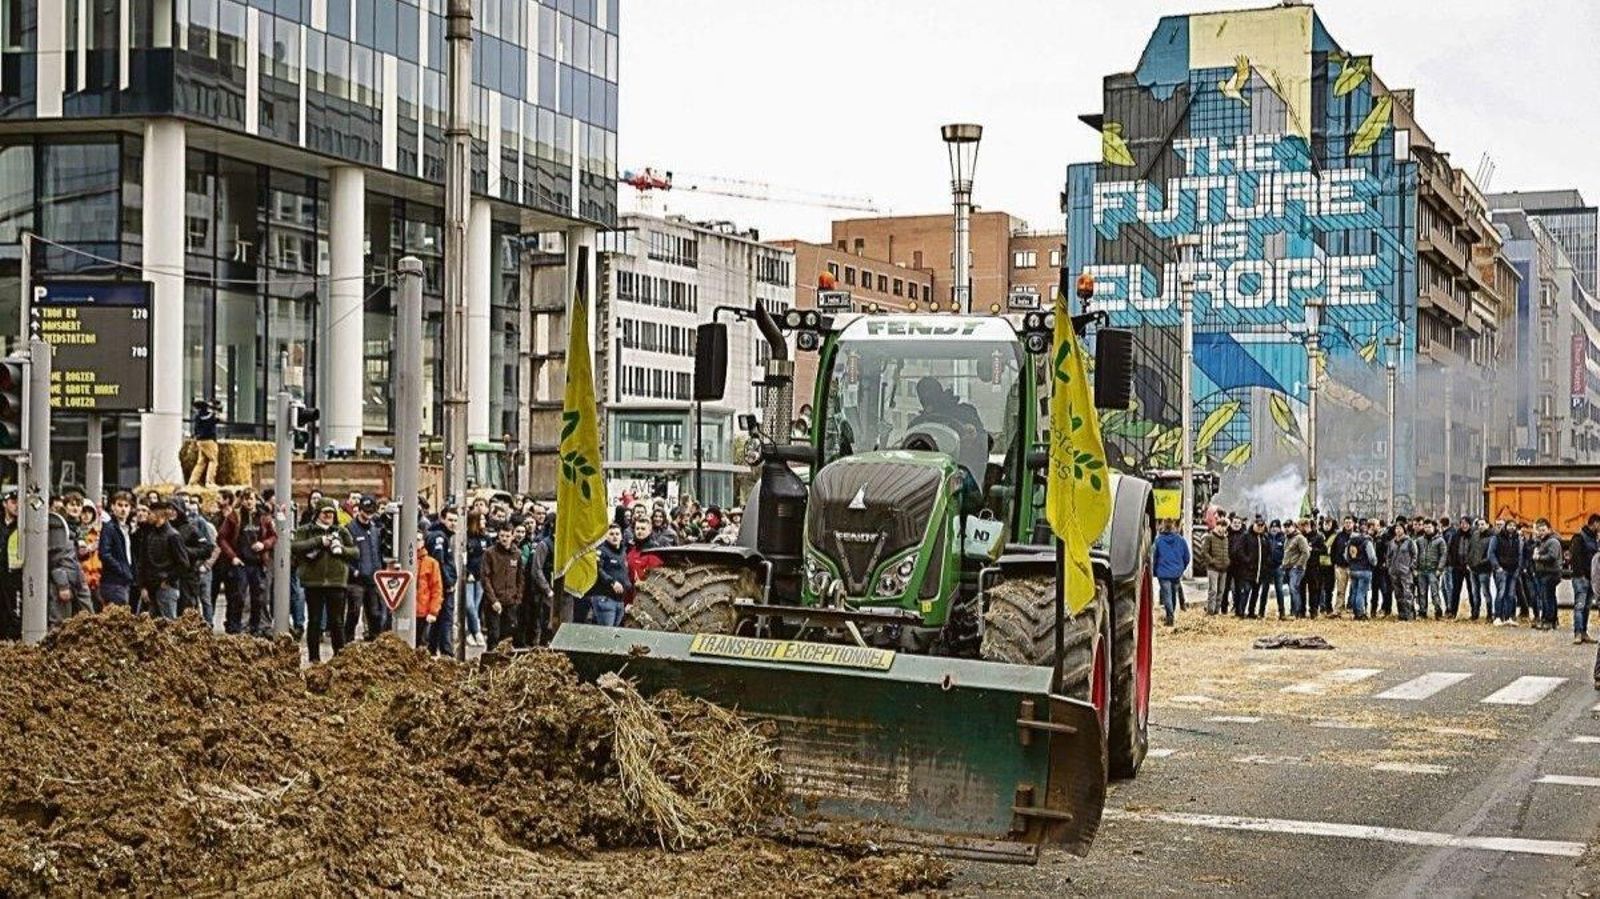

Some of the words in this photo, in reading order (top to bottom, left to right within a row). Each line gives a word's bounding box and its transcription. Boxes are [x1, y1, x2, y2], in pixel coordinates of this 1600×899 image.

[1173, 134, 1282, 174] THE
[1092, 168, 1366, 226] FUTURE
[1201, 222, 1249, 260] IS
[34, 286, 48, 302] P
[1083, 255, 1377, 311] EUROPE
[865, 321, 986, 336] FENDT
[835, 531, 879, 542] FENDT
[697, 635, 782, 658] TRANSPORT
[783, 642, 886, 668] EXCEPTIONNEL
